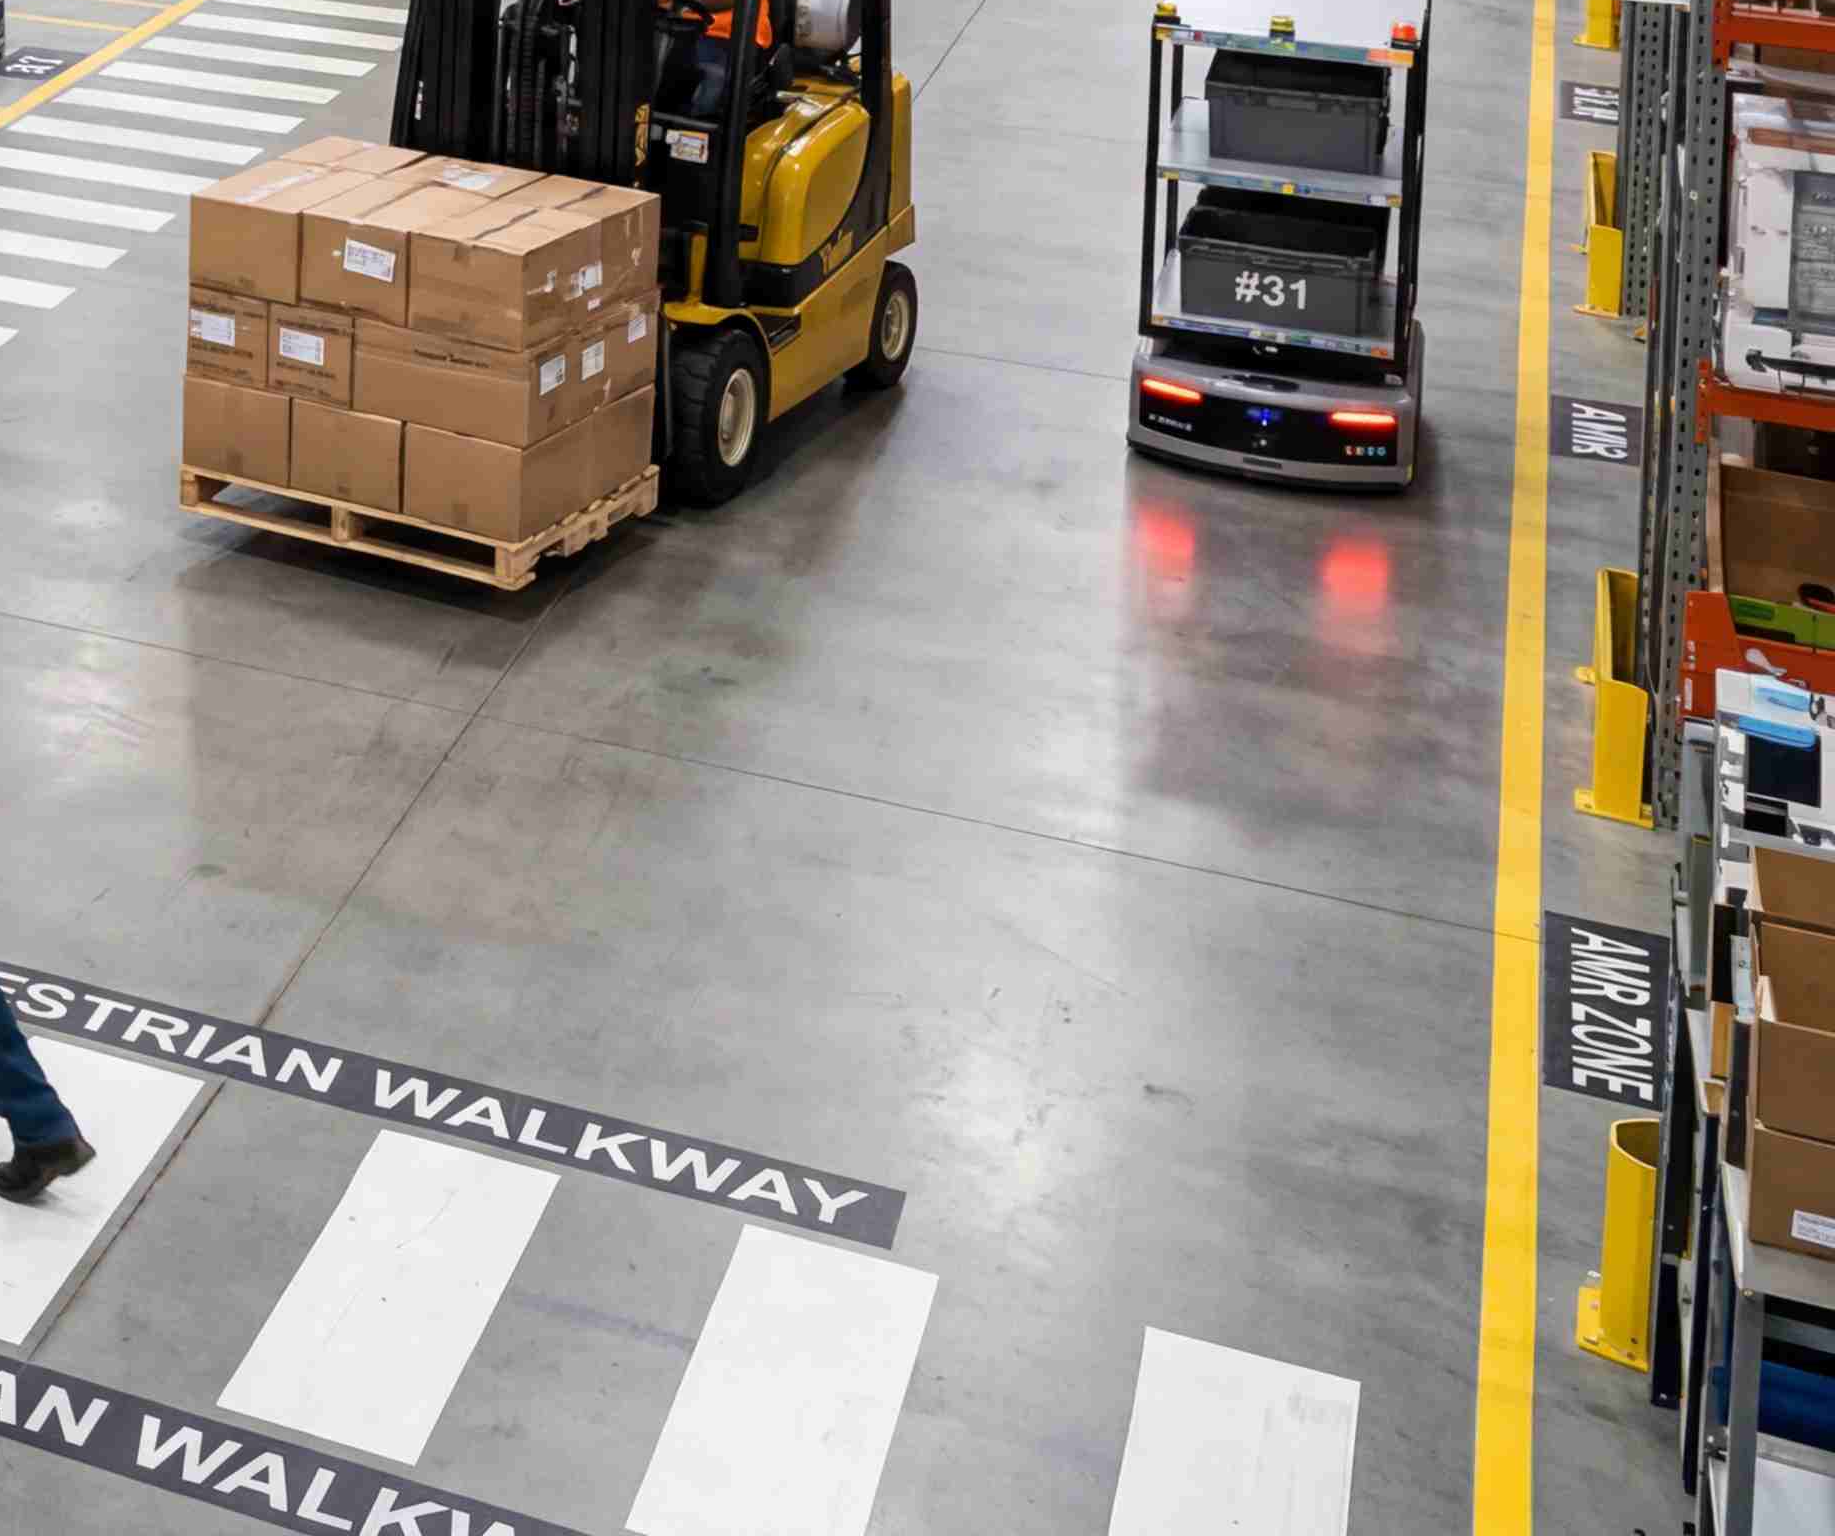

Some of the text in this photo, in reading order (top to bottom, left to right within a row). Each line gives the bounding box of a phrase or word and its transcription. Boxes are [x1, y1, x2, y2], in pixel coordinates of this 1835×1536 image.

[1234, 270, 1308, 310] #31
[1570, 926, 1654, 1102] AMR ZONE
[375, 1070, 868, 1223] WALKWAY
[135, 1414, 515, 1536] WALK
